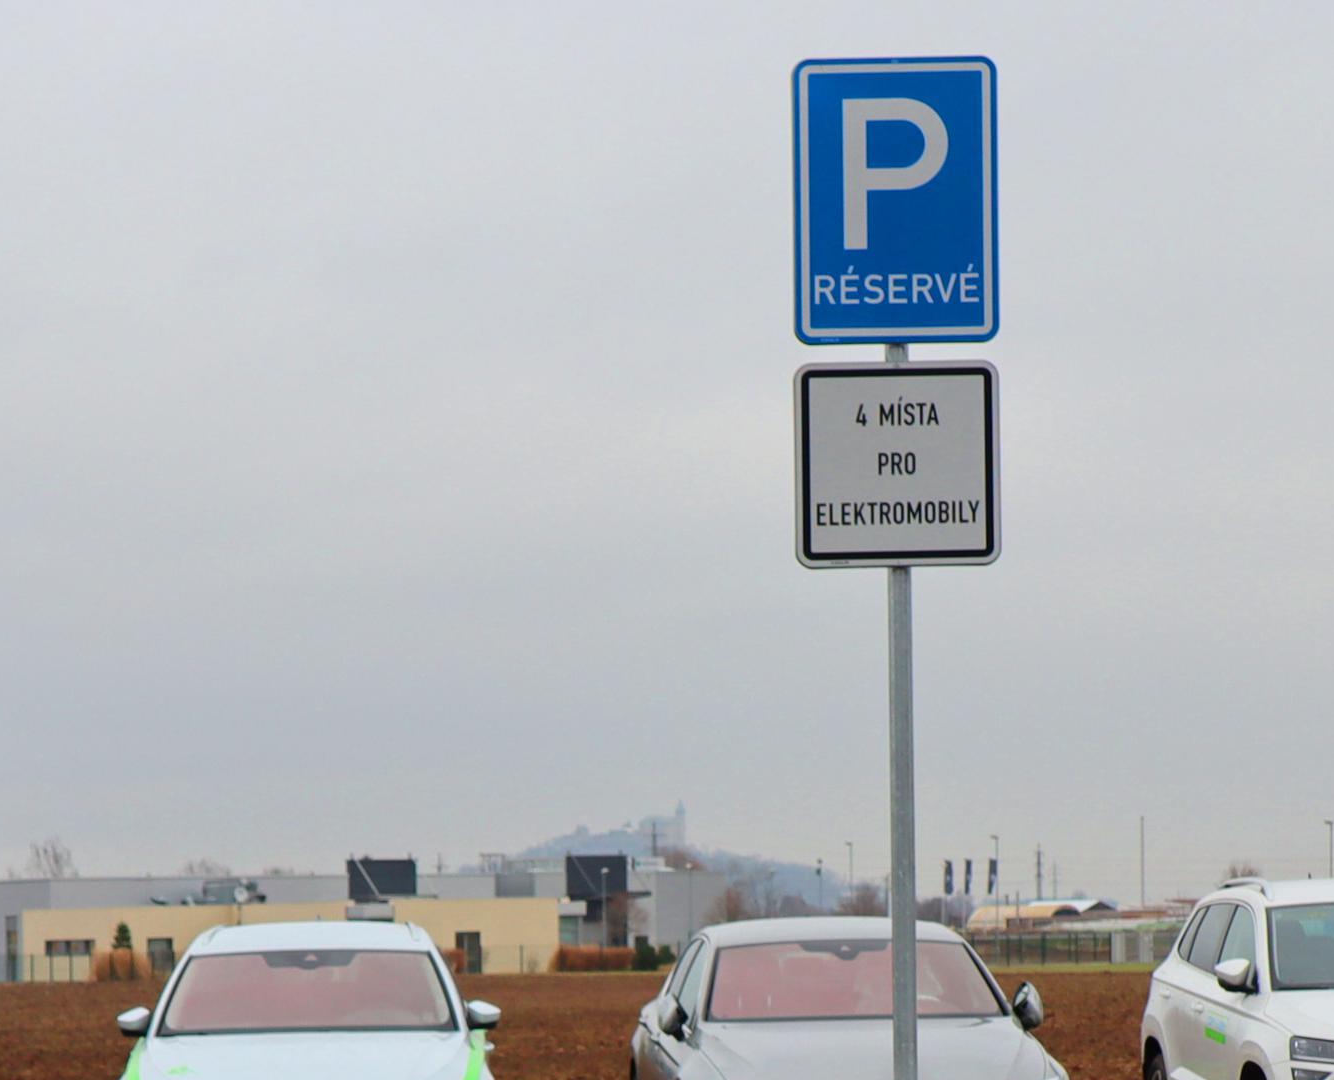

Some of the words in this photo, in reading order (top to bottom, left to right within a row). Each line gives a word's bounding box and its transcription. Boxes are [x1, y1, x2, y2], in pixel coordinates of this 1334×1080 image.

[841, 97, 949, 250] P
[814, 263, 980, 306] RÉSERVÉ
[855, 403, 867, 427] 4
[878, 396, 940, 427] MÍSTA
[877, 452, 916, 476] PRO
[816, 499, 980, 528] ELEKTROMOBILY
